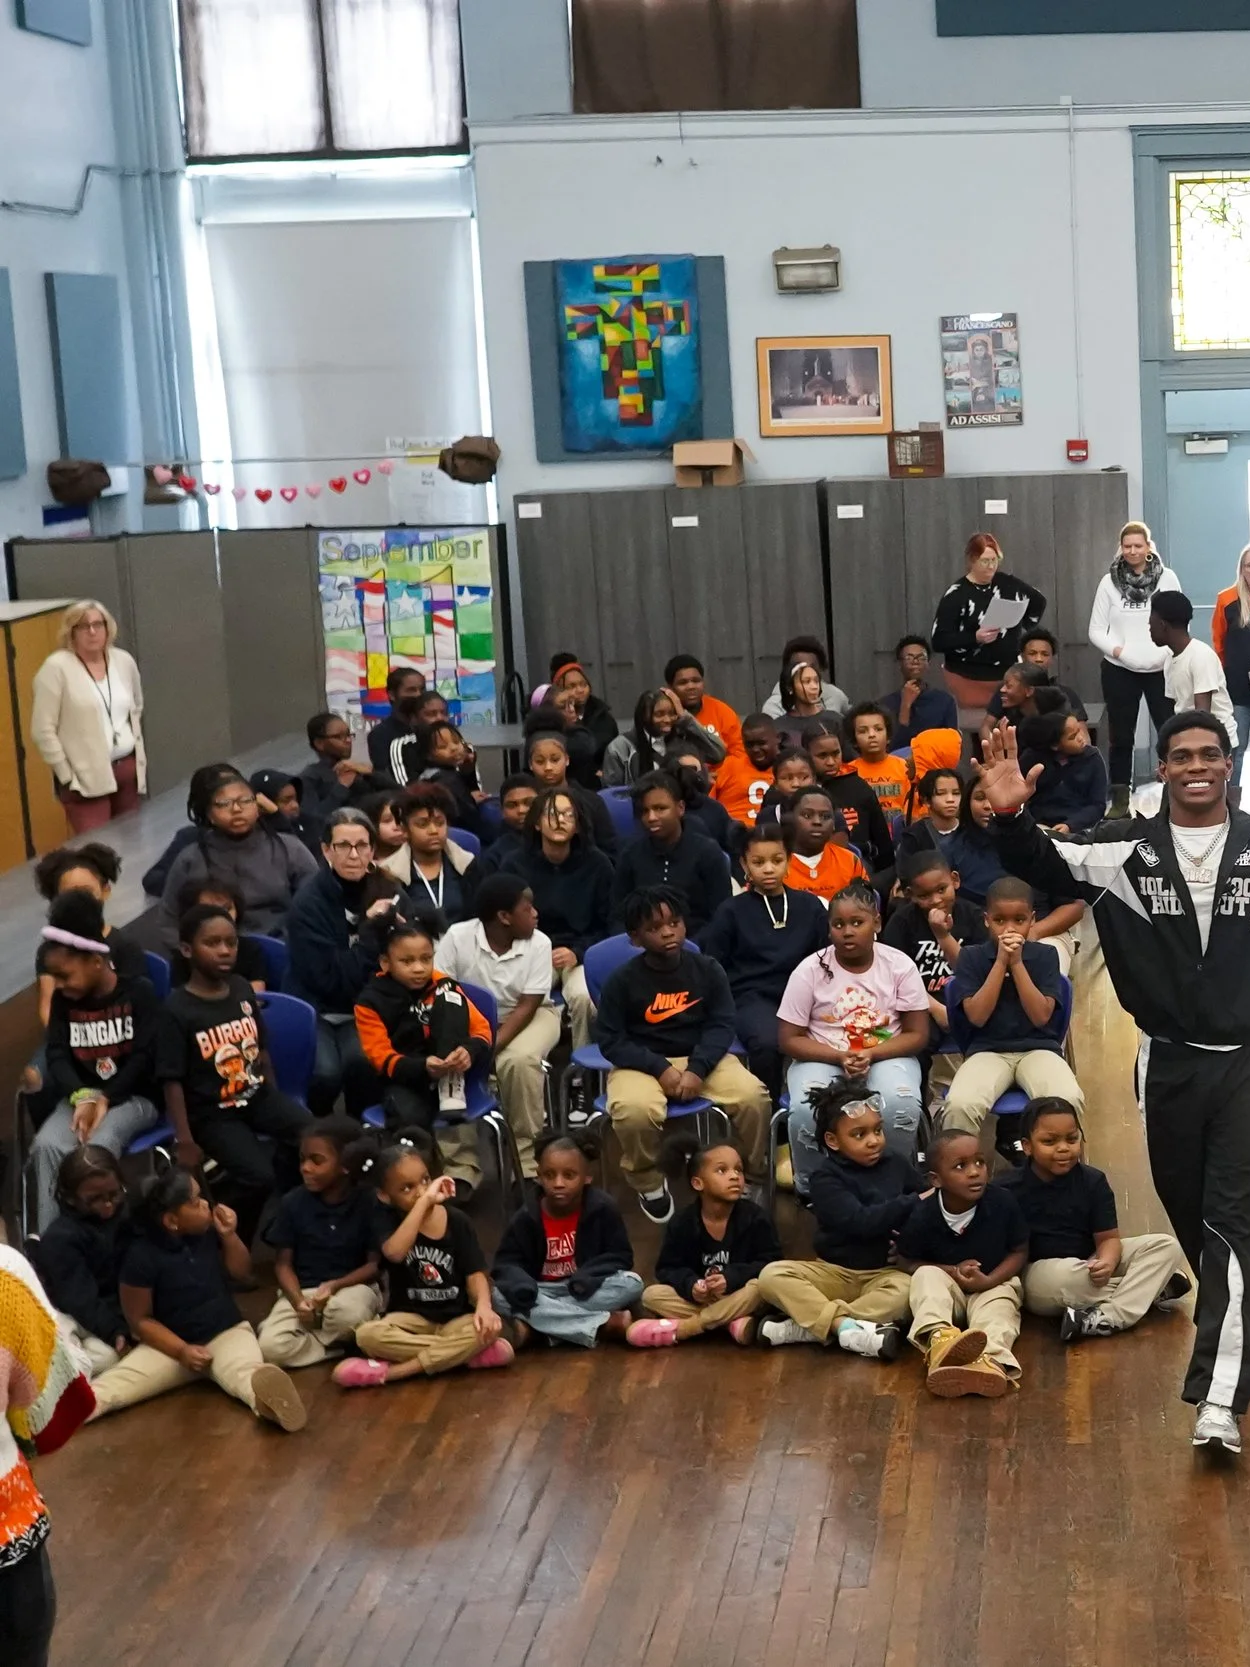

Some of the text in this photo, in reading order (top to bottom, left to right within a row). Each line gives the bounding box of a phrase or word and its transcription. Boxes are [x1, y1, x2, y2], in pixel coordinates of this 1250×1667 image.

[950, 416, 967, 425] AD
[968, 414, 1001, 424] ASSISI
[322, 534, 483, 568] September
[1123, 600, 1147, 609] FEET
[652, 991, 689, 1010] NIKE
[69, 1015, 134, 1048] BENGALS
